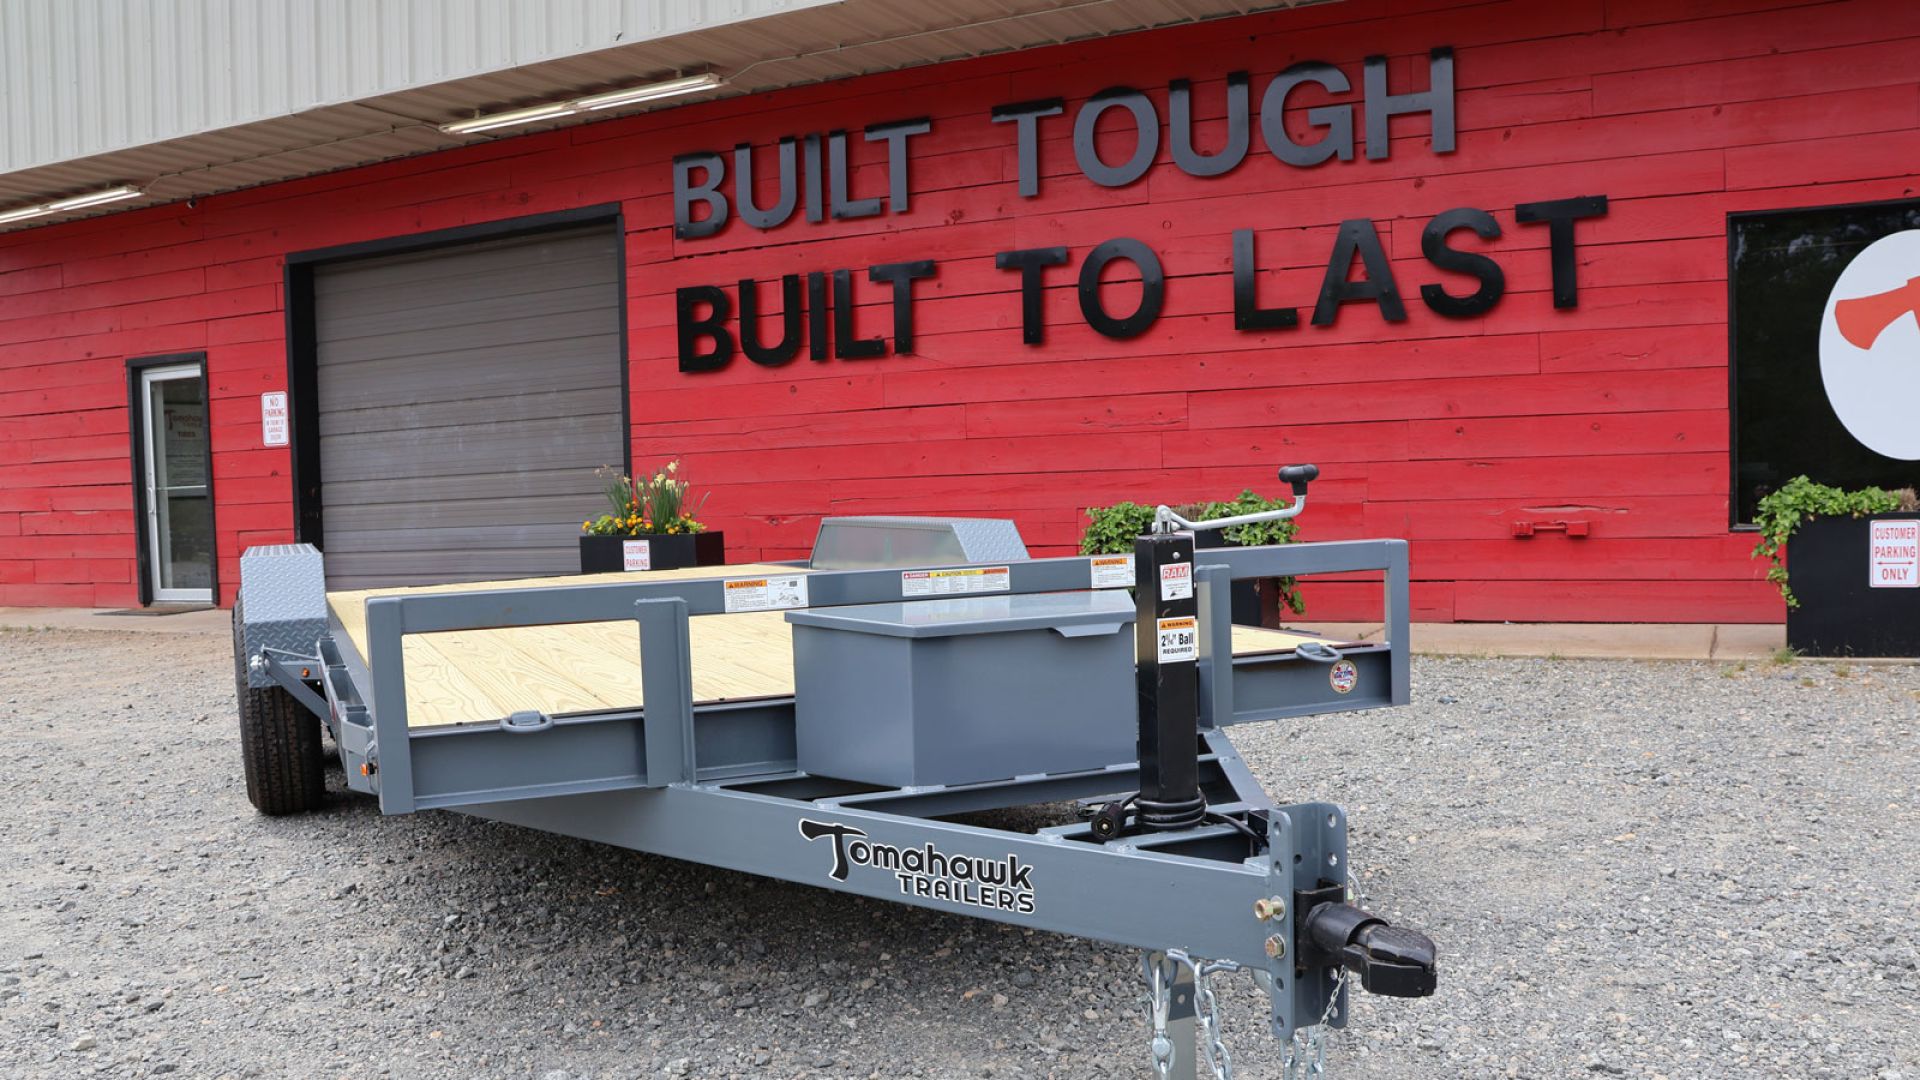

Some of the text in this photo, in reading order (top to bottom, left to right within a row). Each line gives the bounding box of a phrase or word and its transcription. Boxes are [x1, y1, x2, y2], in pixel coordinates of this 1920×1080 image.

[672, 46, 1456, 241] BUILT TOUGH
[676, 195, 1608, 373] BUILT TO LAST
[269, 397, 279, 407] NO
[1875, 527, 1916, 540] CUSTOMER
[1875, 546, 1916, 558] PARKING
[625, 558, 648, 567] PARKING
[1163, 566, 1189, 580] RAM
[1882, 568, 1909, 580] ONLY
[1179, 632, 1194, 646] Ball
[1162, 647, 1193, 655] REQUIRED
[798, 818, 1034, 890] Tomahawk
[896, 872, 1035, 914] TRAILERS
